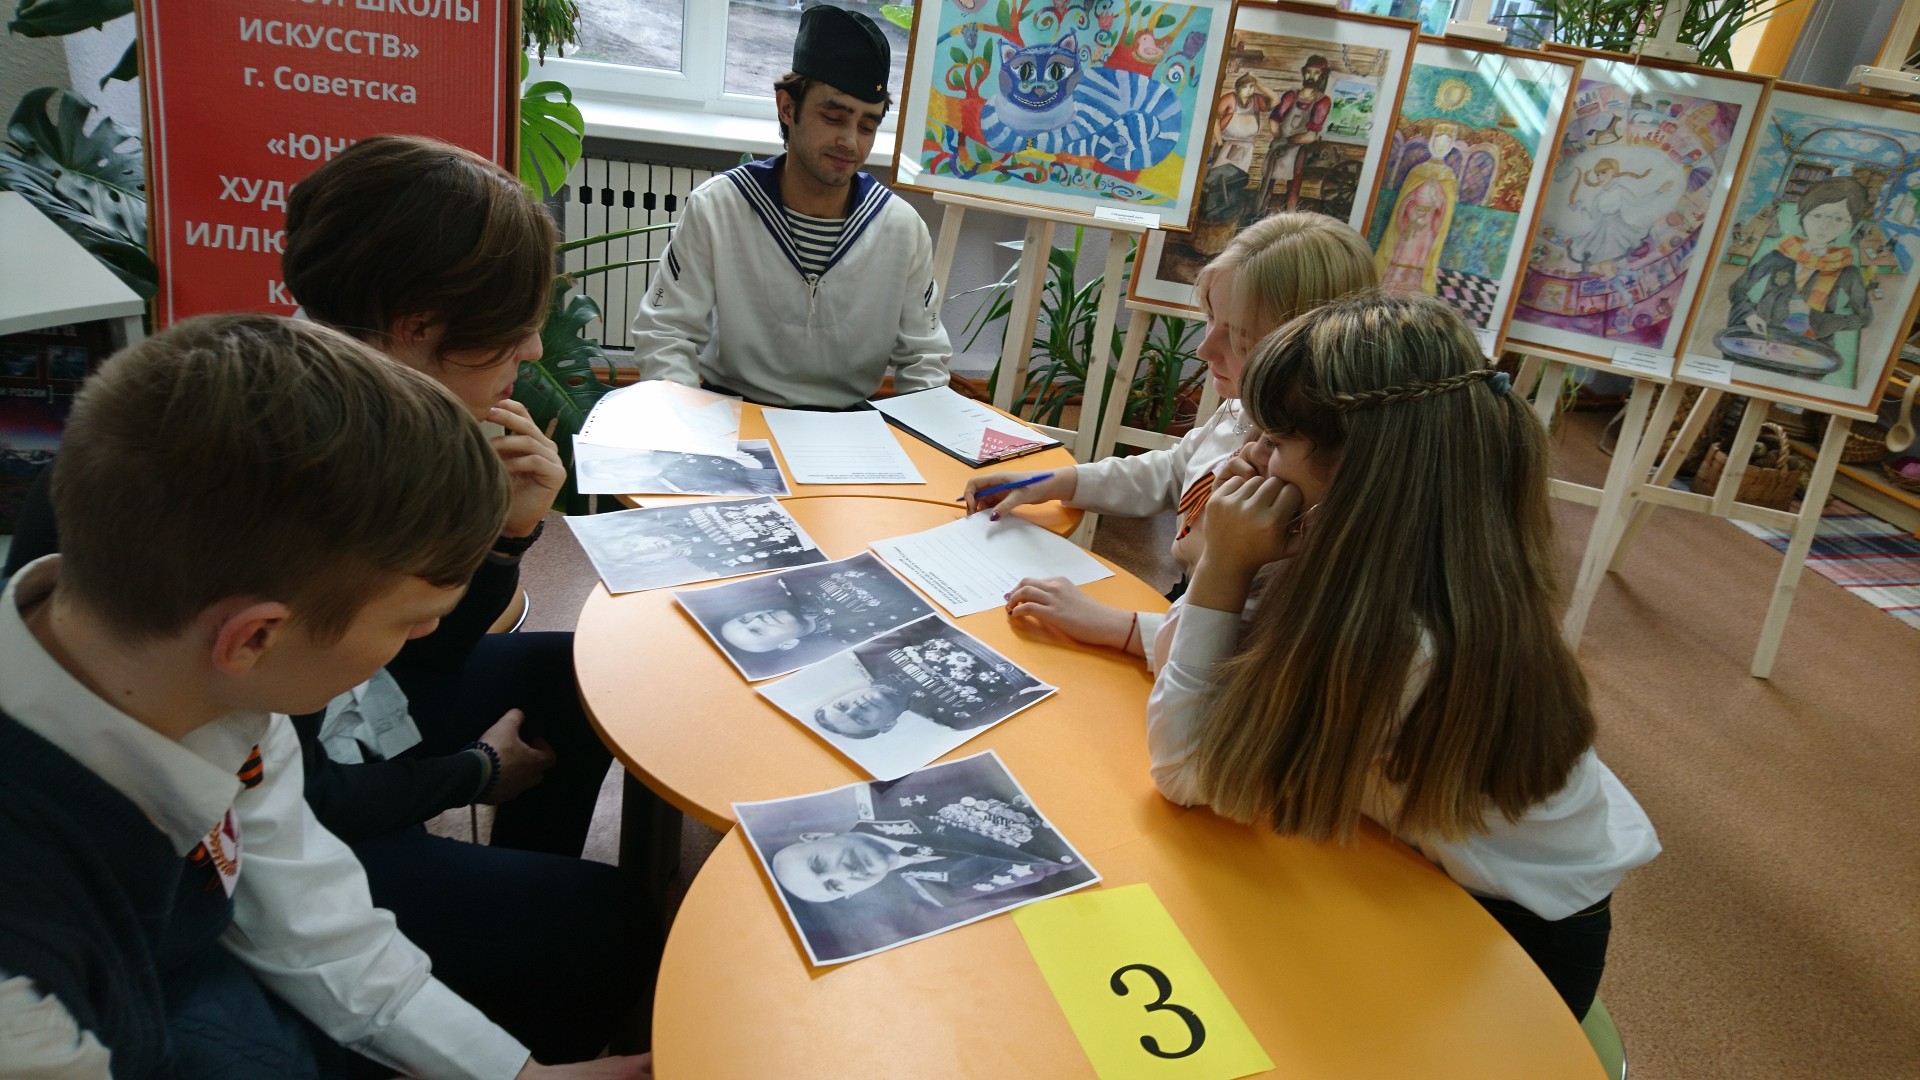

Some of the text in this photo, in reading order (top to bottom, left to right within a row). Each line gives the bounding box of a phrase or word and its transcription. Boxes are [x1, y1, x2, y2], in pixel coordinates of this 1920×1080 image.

[239, 16, 419, 58] ИСКУССТВ»
[244, 65, 417, 104] г. Советска
[218, 174, 299, 213] ХУД
[1110, 963, 1206, 1059] 3
